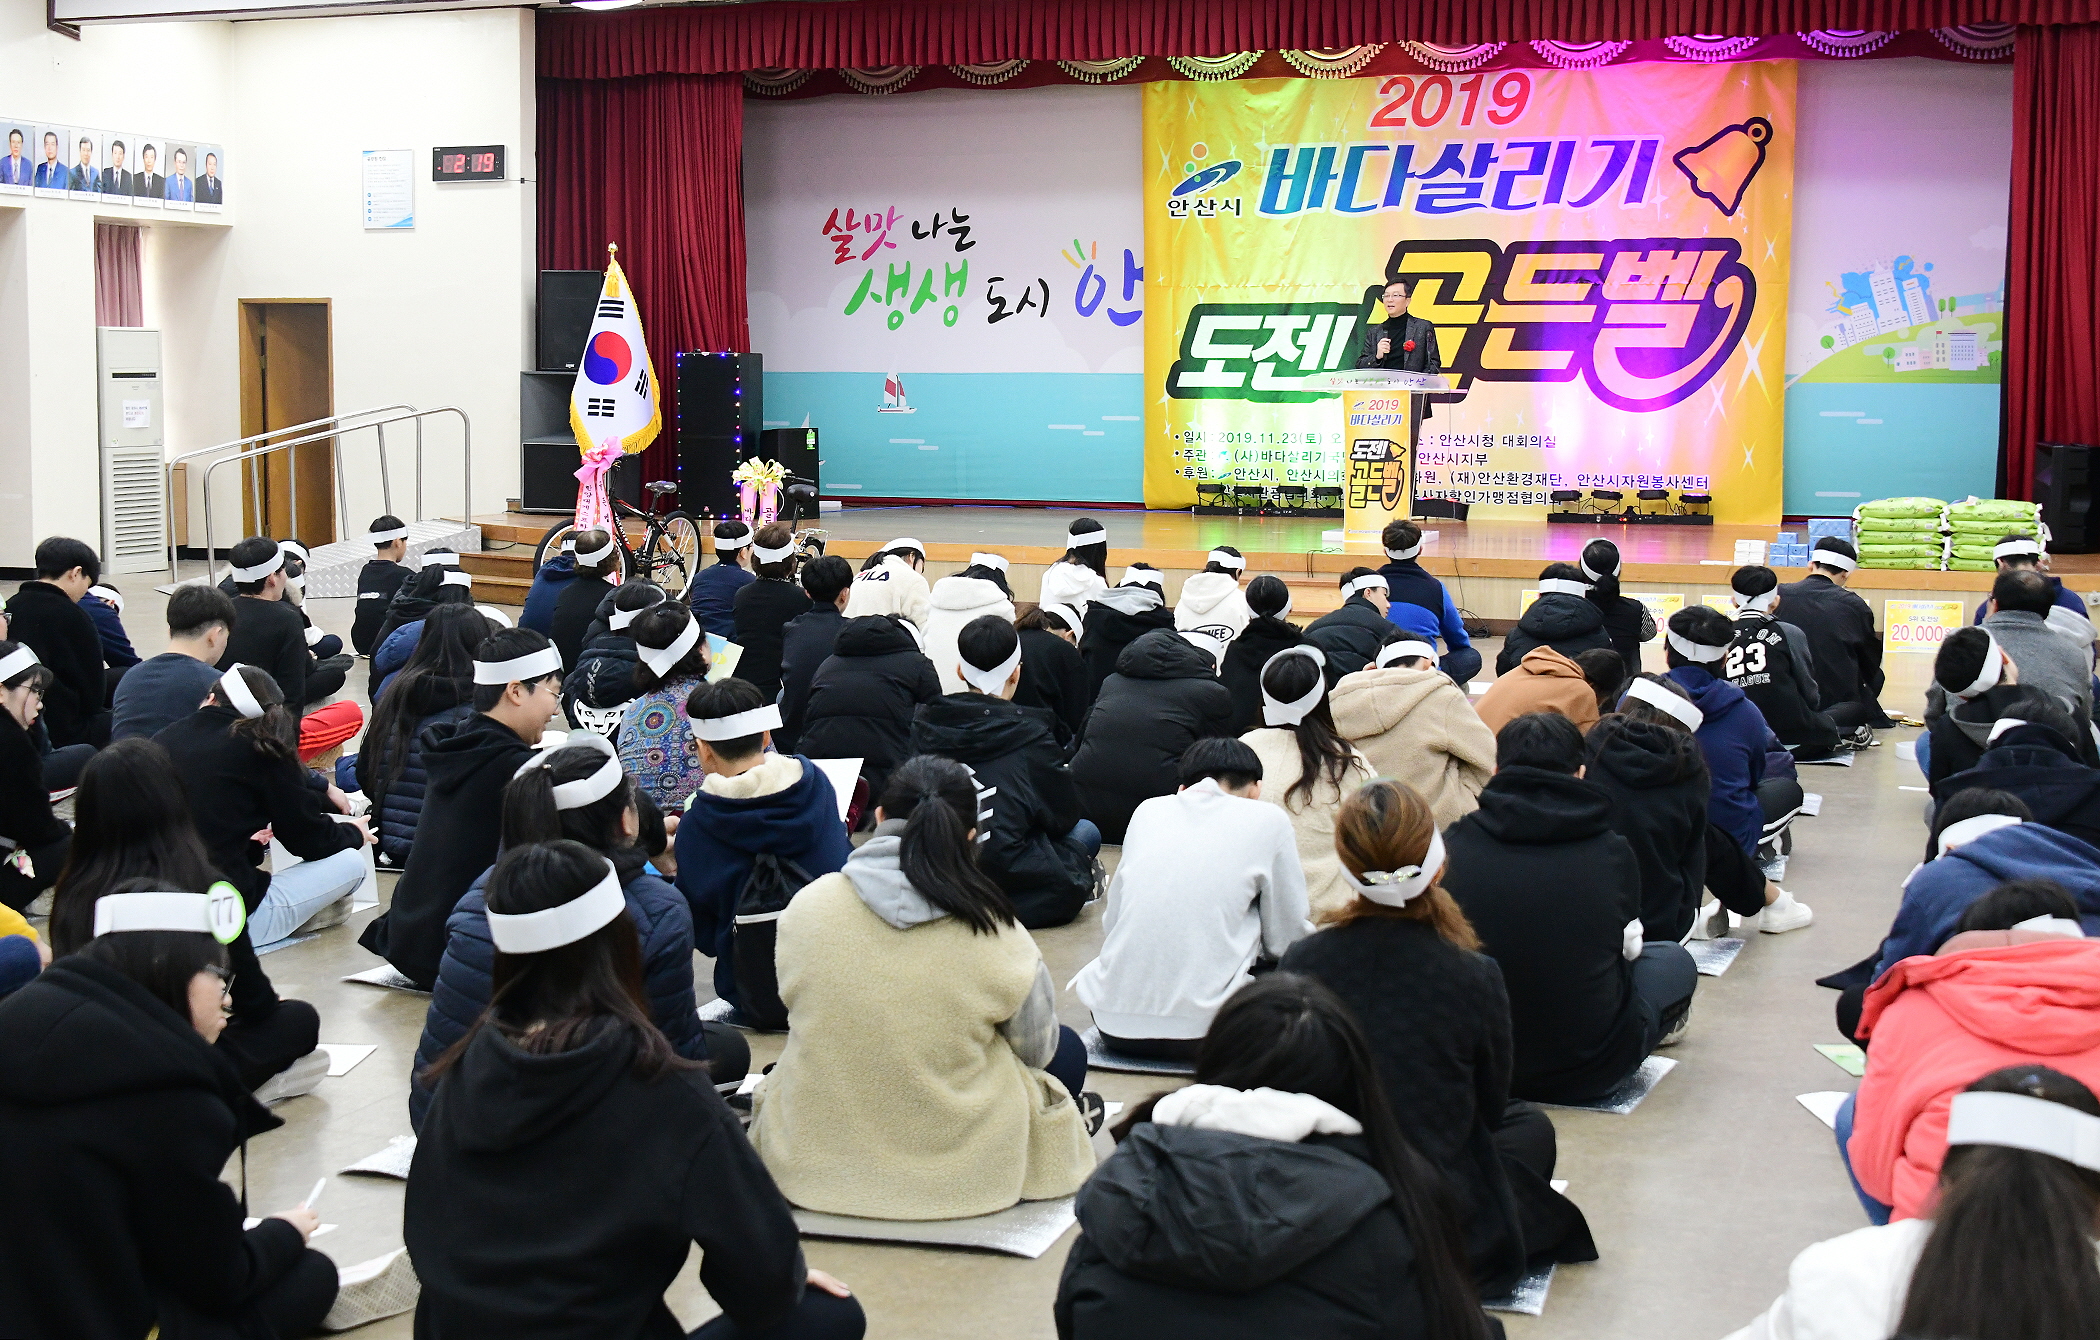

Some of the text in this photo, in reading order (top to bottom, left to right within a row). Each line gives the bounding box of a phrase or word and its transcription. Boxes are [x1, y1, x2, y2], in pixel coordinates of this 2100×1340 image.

[1370, 72, 1531, 128] 2019
[1259, 139, 1660, 215] 바다살리기
[1168, 198, 1241, 217] 안산시
[822, 205, 977, 265] 살맛 나는
[843, 258, 969, 331] 생생
[986, 277, 1050, 324] 도시
[1367, 399, 1400, 411] 2019
[1349, 413, 1403, 426] 바다살리기
[1439, 434, 1494, 448] 안산시청
[1502, 435, 1556, 449] 대회의실
[1234, 449, 1345, 464] (사)바다살리기국
[1418, 452, 1488, 467] 안산시지부
[1234, 468, 1279, 482] 안산시,
[1287, 469, 1345, 483] 안산시의
[1450, 471, 1568, 487] (재)안산환경재단,
[1577, 473, 1708, 490] 안산시자원봉사센터
[1349, 460, 1405, 511] 골든벨
[1726, 641, 1767, 679] 23
[211, 895, 235, 926] 77
